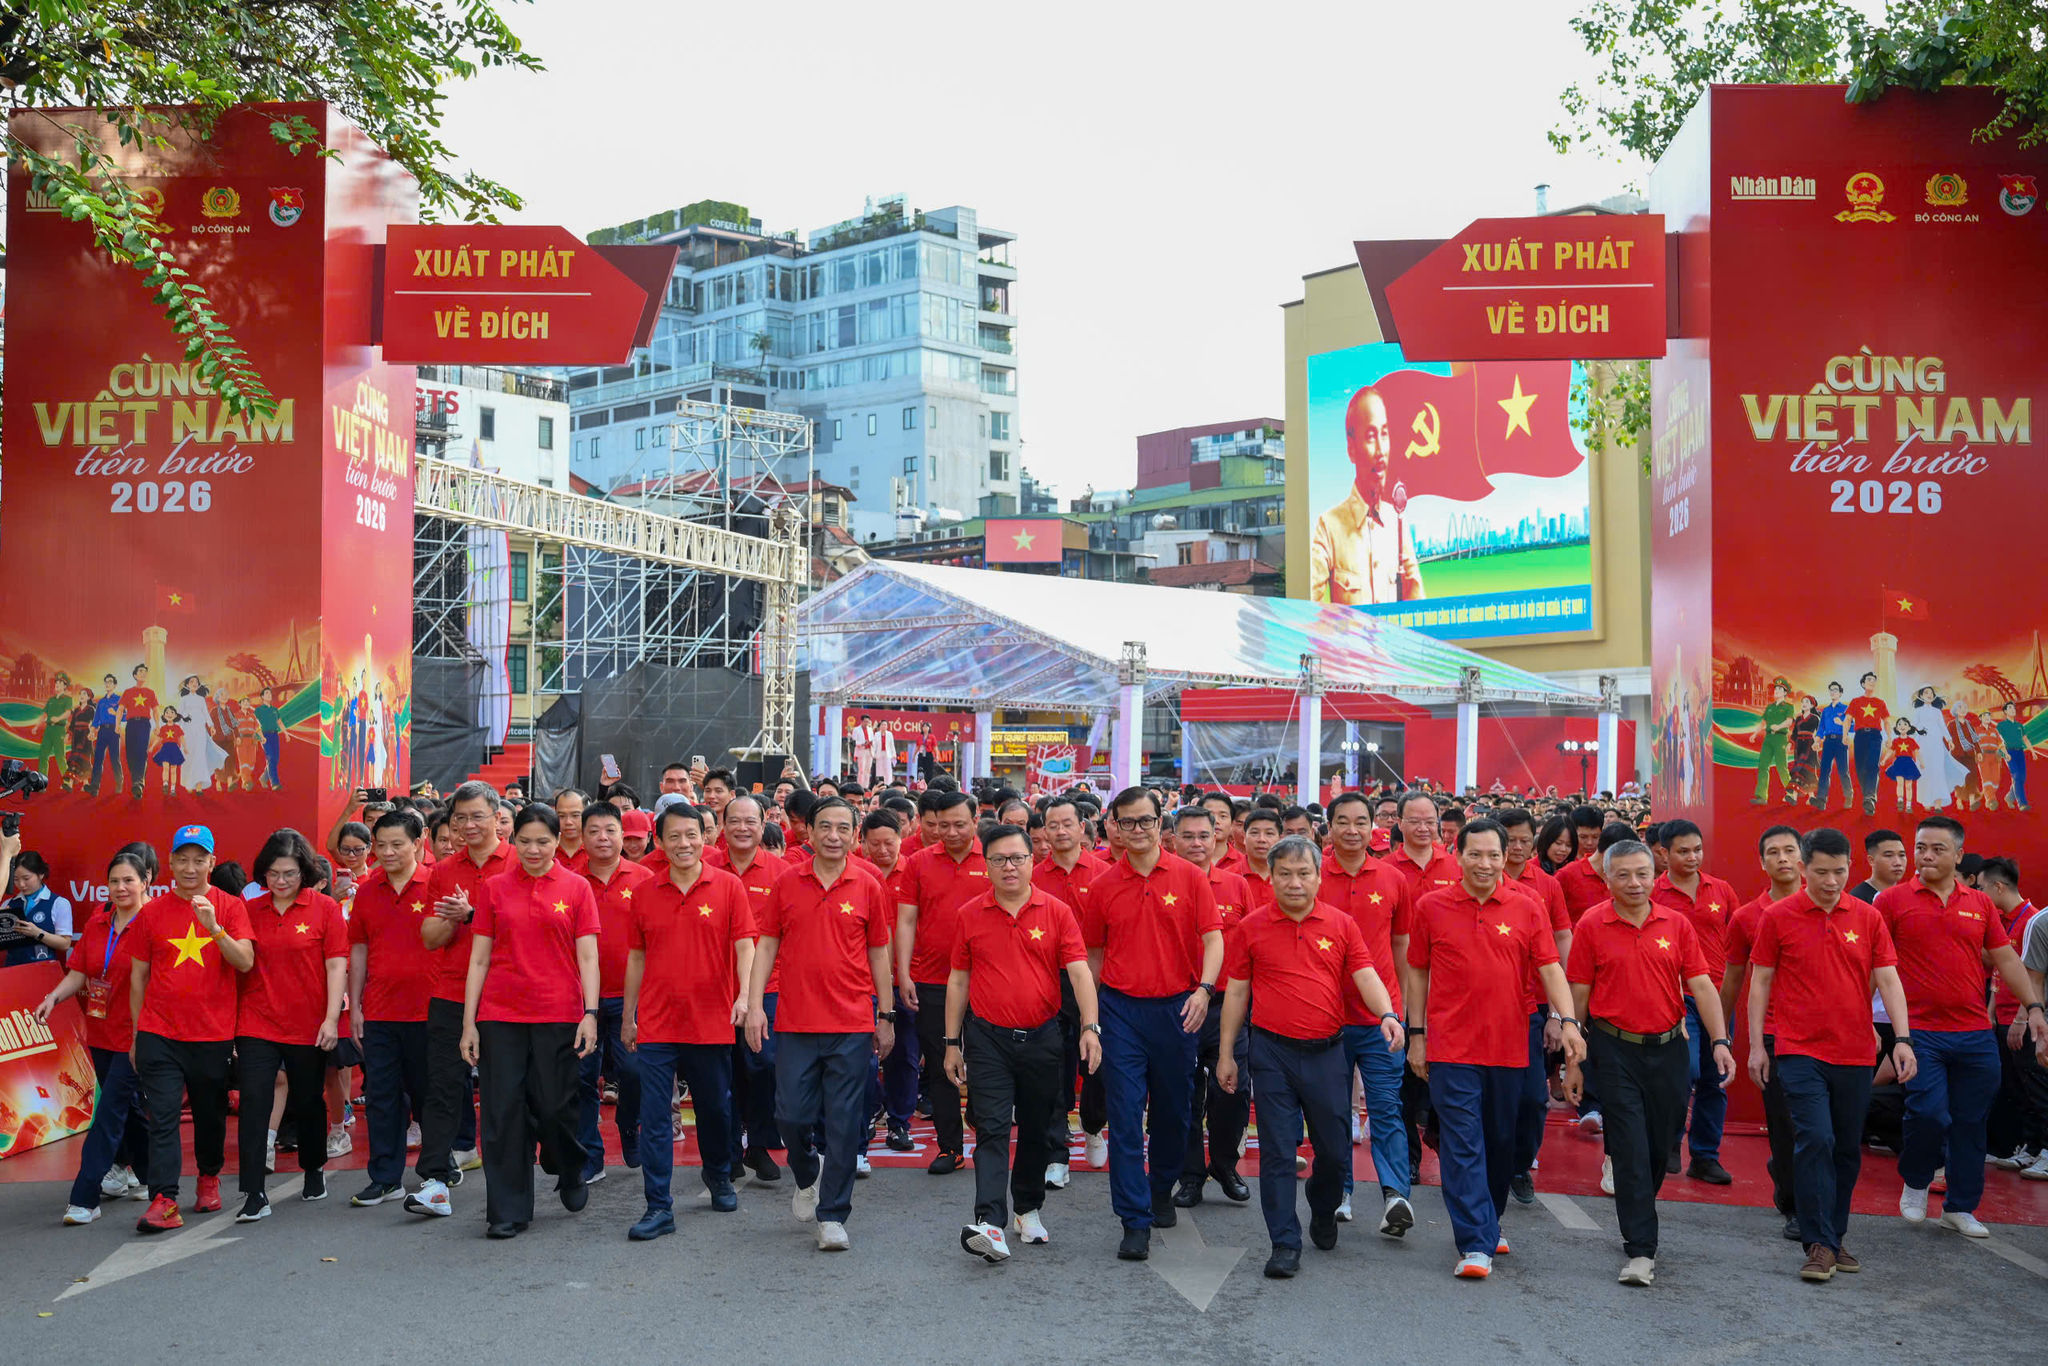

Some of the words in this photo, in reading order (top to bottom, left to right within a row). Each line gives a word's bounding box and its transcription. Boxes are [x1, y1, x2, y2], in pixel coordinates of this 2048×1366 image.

[1731, 176, 1778, 195] Nhân
[1780, 176, 1816, 195] Dân
[192, 223, 205, 235] BỘ
[207, 223, 236, 234] CÔNG
[238, 224, 250, 233] AN
[1915, 213, 1930, 224] BỘ
[1932, 212, 1962, 223] CÔNG
[1964, 214, 1980, 223] AN
[413, 243, 490, 277] XUẤT
[500, 245, 575, 278] PHÁT
[1461, 236, 1543, 272] XUẤT
[1555, 235, 1634, 270] PHÁT
[434, 305, 470, 338] VỀ
[480, 306, 549, 339] ĐÍCH
[1486, 300, 1525, 334] VỀ
[1535, 299, 1609, 334] ĐÍCH
[1825, 344, 1946, 393] CÙNG
[356, 375, 389, 426] CÙNG
[1740, 383, 1880, 450] VIỆT
[1895, 397, 2032, 445] NAM
[32, 390, 159, 454] VIỆT
[171, 398, 295, 445] NAM
[75, 440, 150, 476] tiến
[158, 431, 255, 474] bước
[332, 404, 372, 467] VIỆT
[375, 425, 408, 479] NAM
[1789, 436, 1873, 473] tiến
[1882, 431, 1989, 475] bước
[111, 480, 212, 513] 2026
[356, 494, 386, 532] 2026
[1830, 479, 1943, 513] 2026
[1669, 496, 1689, 537] 2026
